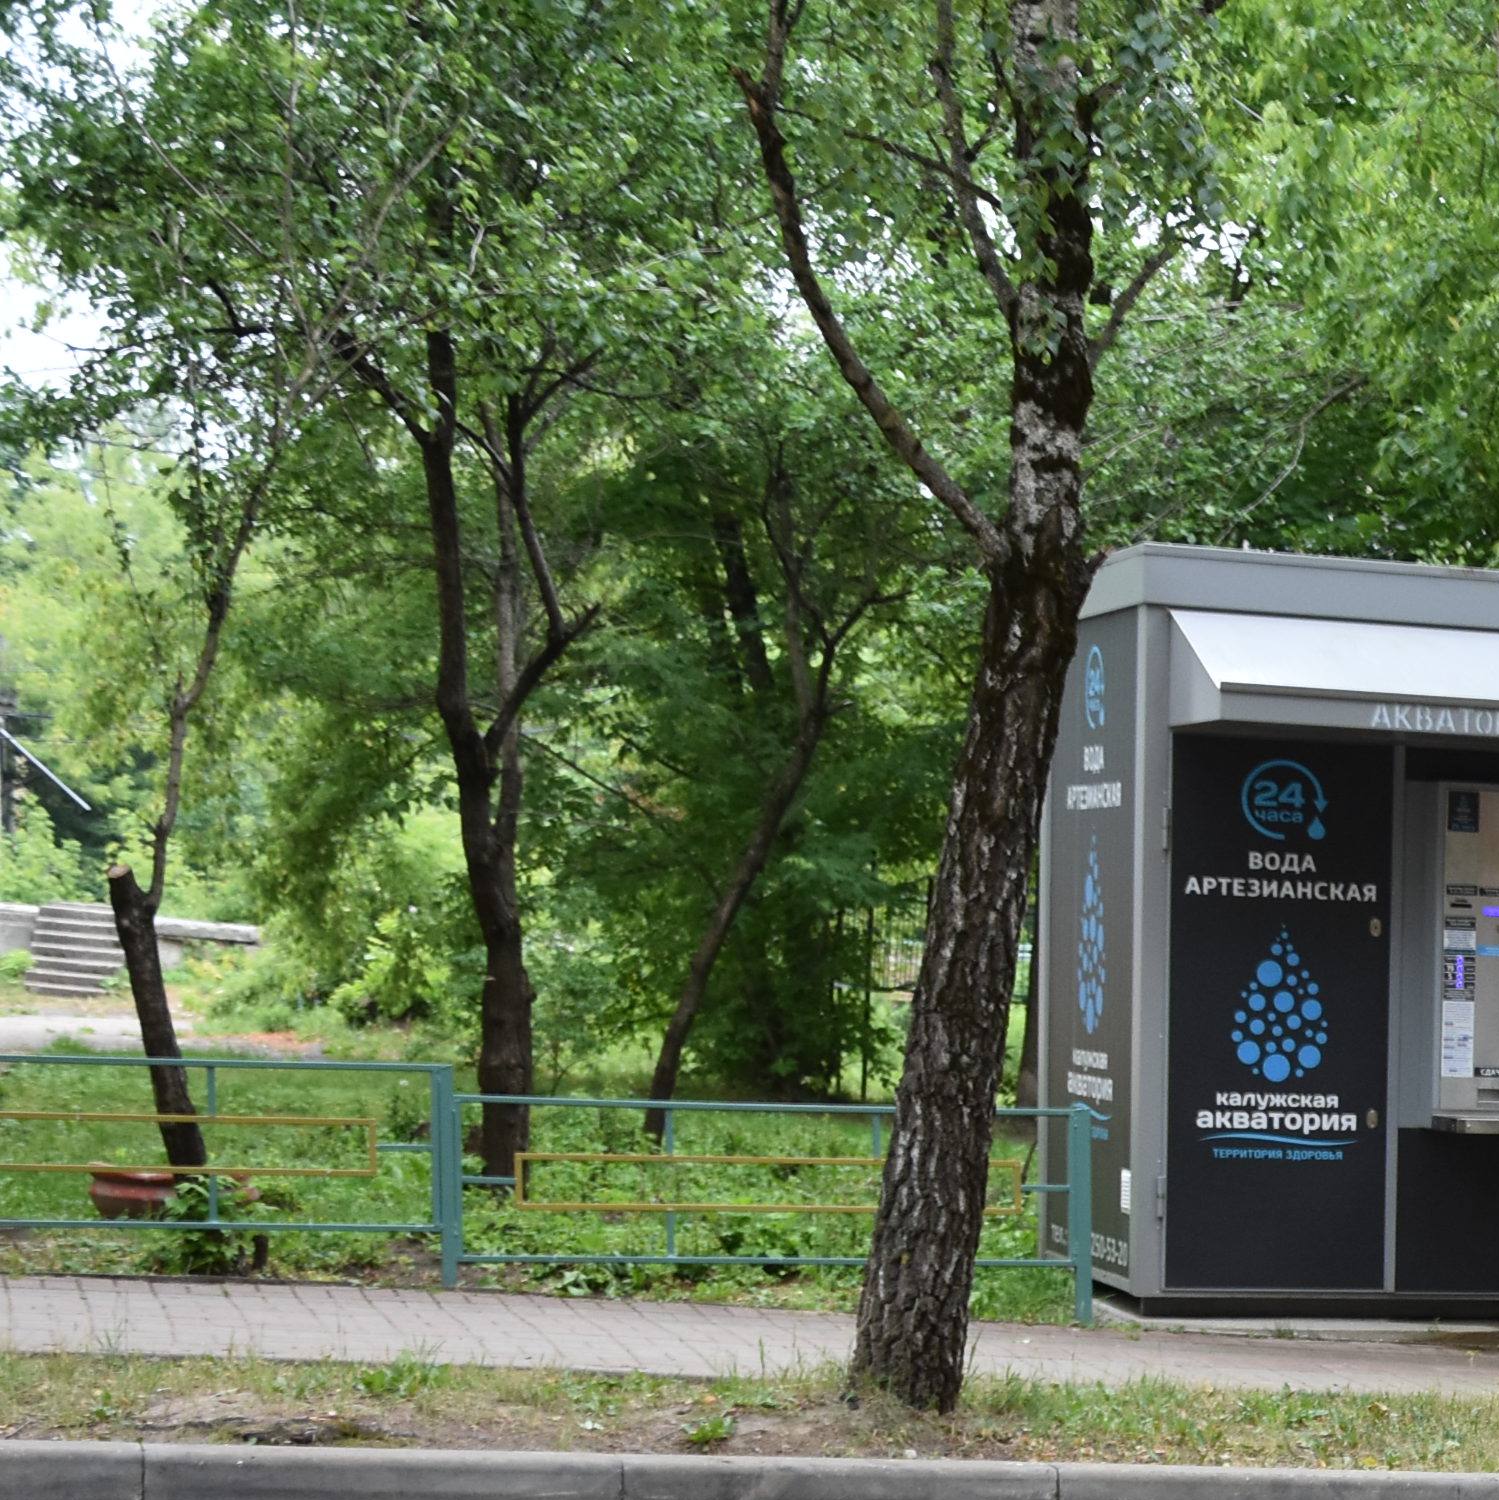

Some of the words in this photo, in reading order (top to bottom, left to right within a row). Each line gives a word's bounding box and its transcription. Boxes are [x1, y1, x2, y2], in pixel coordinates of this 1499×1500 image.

[1254, 780, 1305, 808] 24
[1254, 809, 1304, 824] часа
[1248, 850, 1317, 875] ВОДА
[1184, 875, 1378, 902] АРТЕЗИАНСКАЯ
[1215, 1090, 1340, 1110] калужская
[1195, 1109, 1358, 1135] акватория
[1212, 1147, 1283, 1160] ТЕРРИТОРИЯ
[1285, 1149, 1344, 1161] ЗДОРОВЬЯ
